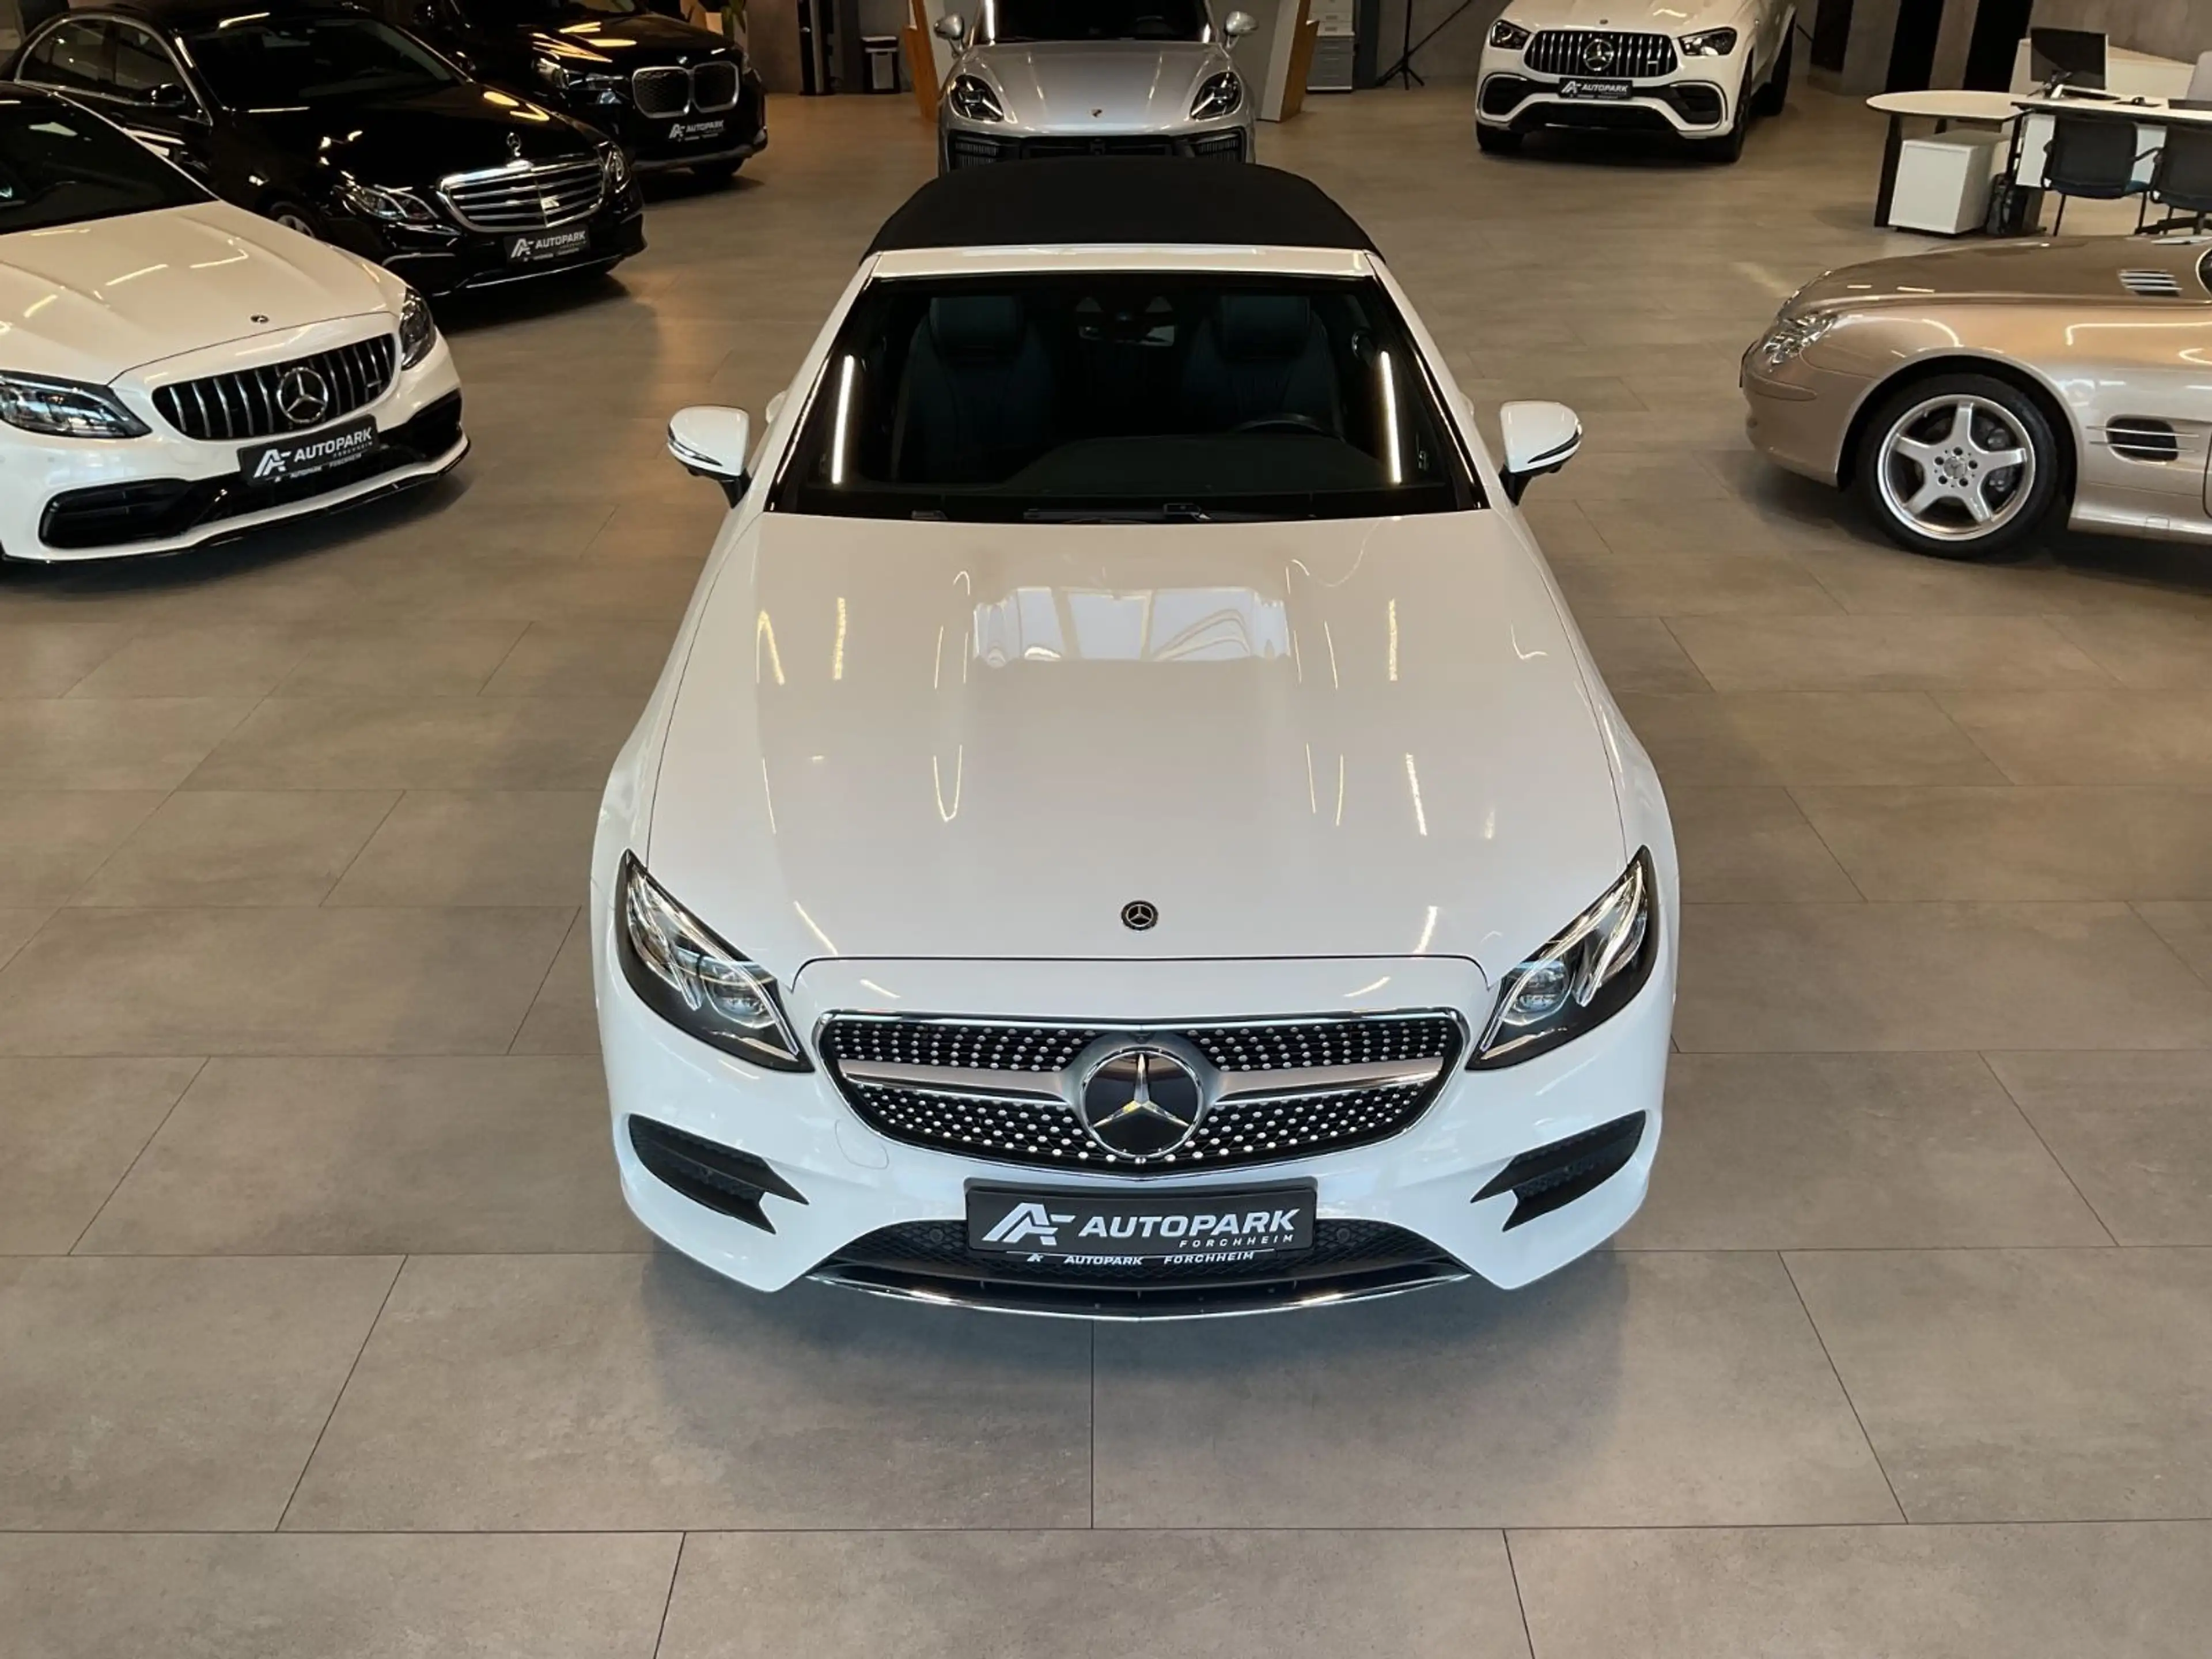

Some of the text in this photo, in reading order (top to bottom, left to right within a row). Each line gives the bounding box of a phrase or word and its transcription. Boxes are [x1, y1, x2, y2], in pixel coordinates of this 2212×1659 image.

[535, 230, 586, 249] AUTOPARK
[294, 426, 372, 463] AUTOPARK
[1078, 1209, 1301, 1238] AUTOPARK
[1179, 1234, 1294, 1249] FORCHHEIM
[1063, 1251, 1255, 1266] AUTOPARK FORCHHEIM
